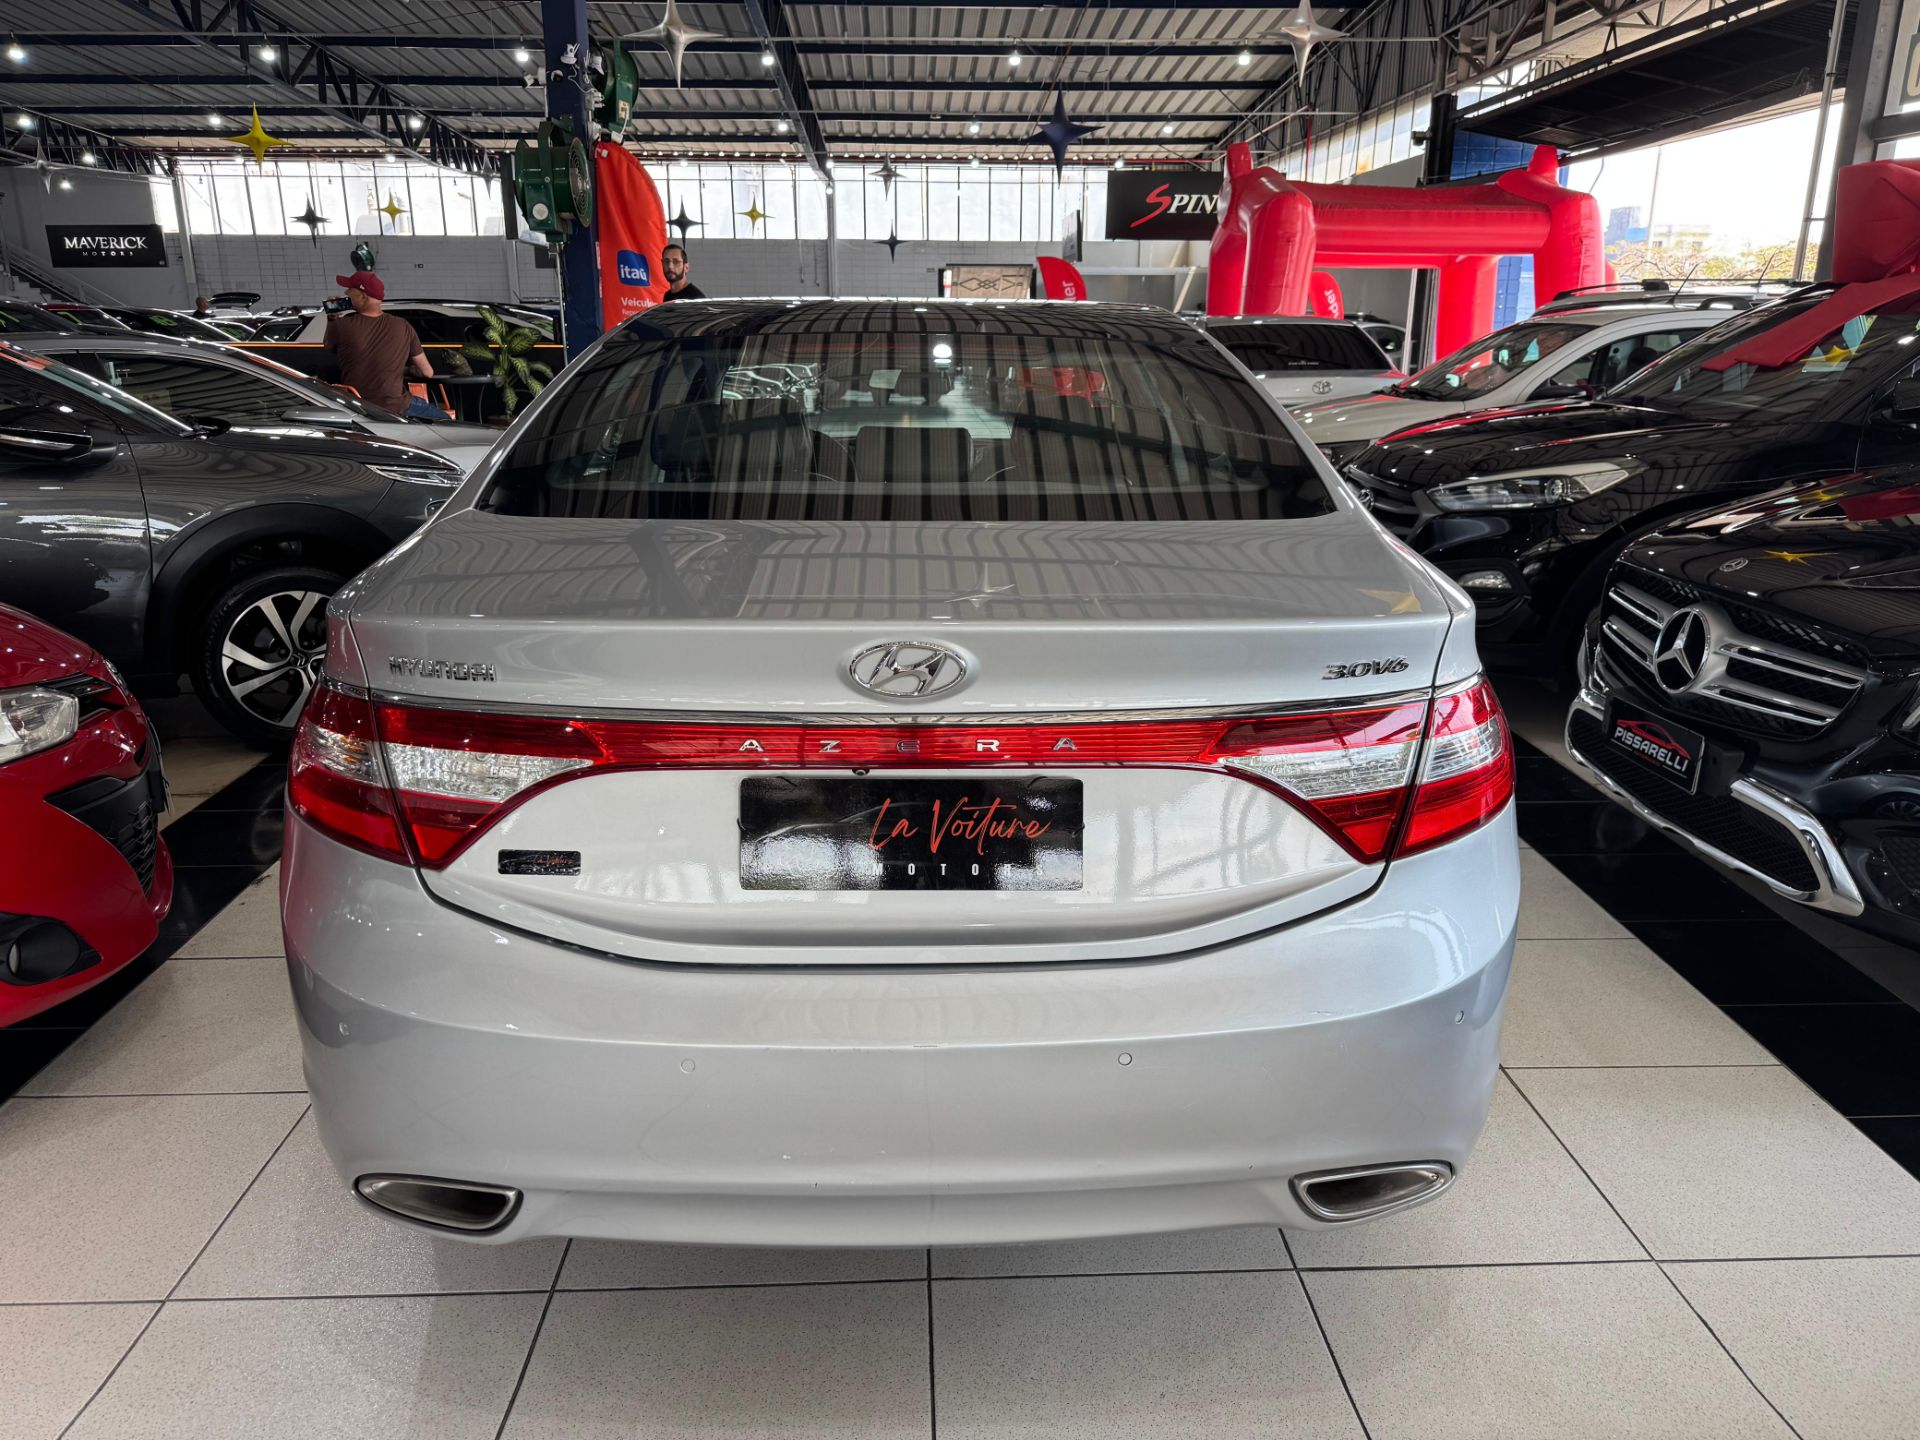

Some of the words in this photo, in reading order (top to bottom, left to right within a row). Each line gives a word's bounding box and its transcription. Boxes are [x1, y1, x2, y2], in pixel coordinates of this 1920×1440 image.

[1129, 183, 1219, 228] SPIN
[63, 236, 148, 249] MAVERICK
[620, 264, 647, 281] itaú
[388, 656, 496, 682] HYUNDAI
[738, 737, 1078, 753] AZERA
[1613, 726, 1689, 773] PISSARELLI
[867, 797, 919, 851] La
[928, 796, 1052, 856] Voiture
[872, 863, 1044, 876] MOTORS
